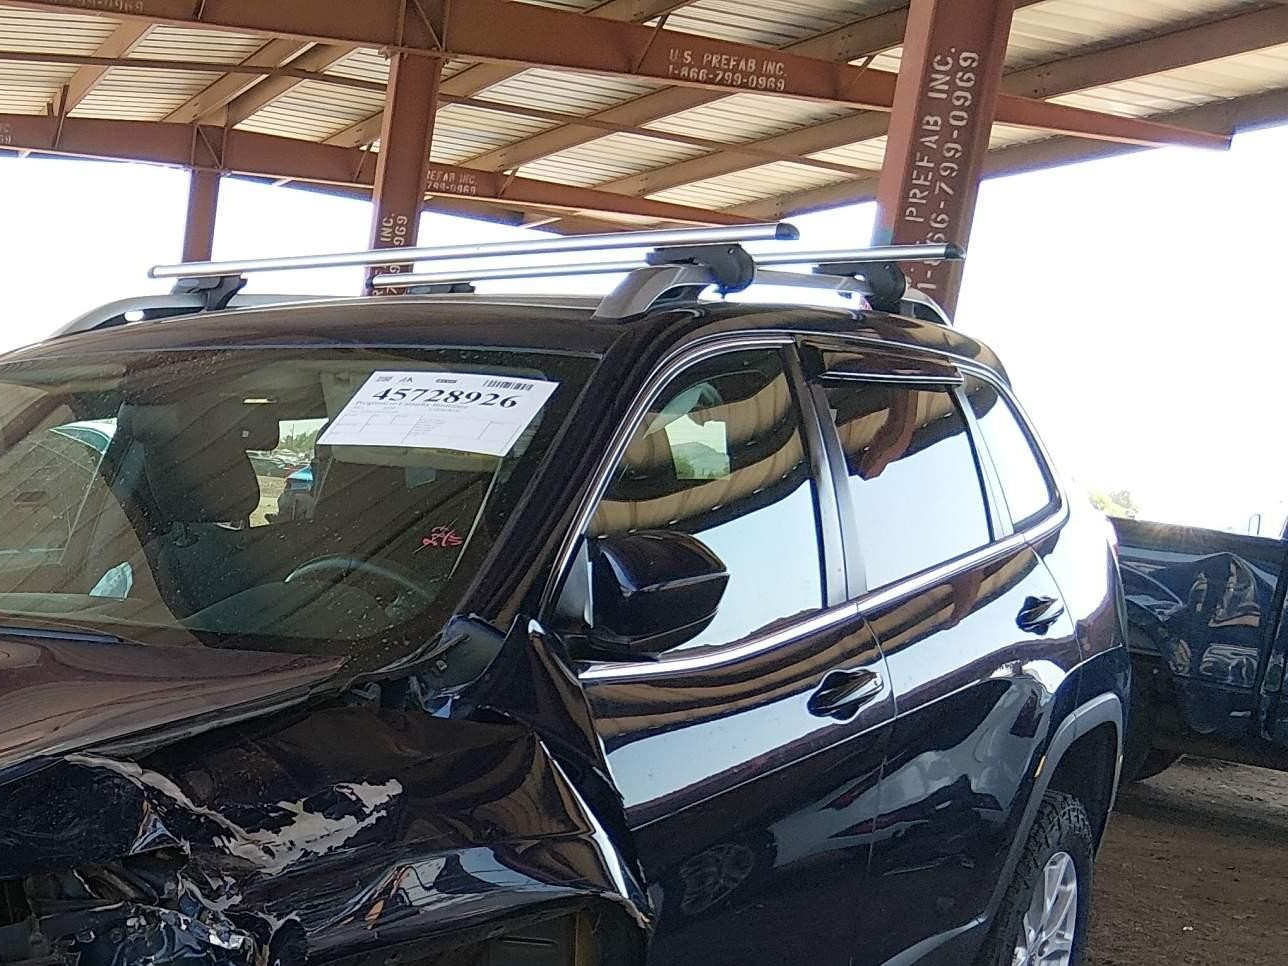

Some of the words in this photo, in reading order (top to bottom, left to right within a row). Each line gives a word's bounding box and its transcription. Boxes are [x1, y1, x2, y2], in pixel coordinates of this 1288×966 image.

[668, 64, 785, 91] 1-866-799-0969
[703, 53, 756, 72] PREFAB
[762, 60, 788, 77] INC.
[904, 114, 943, 222] PREFAB
[927, 47, 956, 100] INC.
[426, 181, 477, 194] 799-0969
[380, 213, 395, 242] INC.
[372, 388, 521, 408] 45728926
